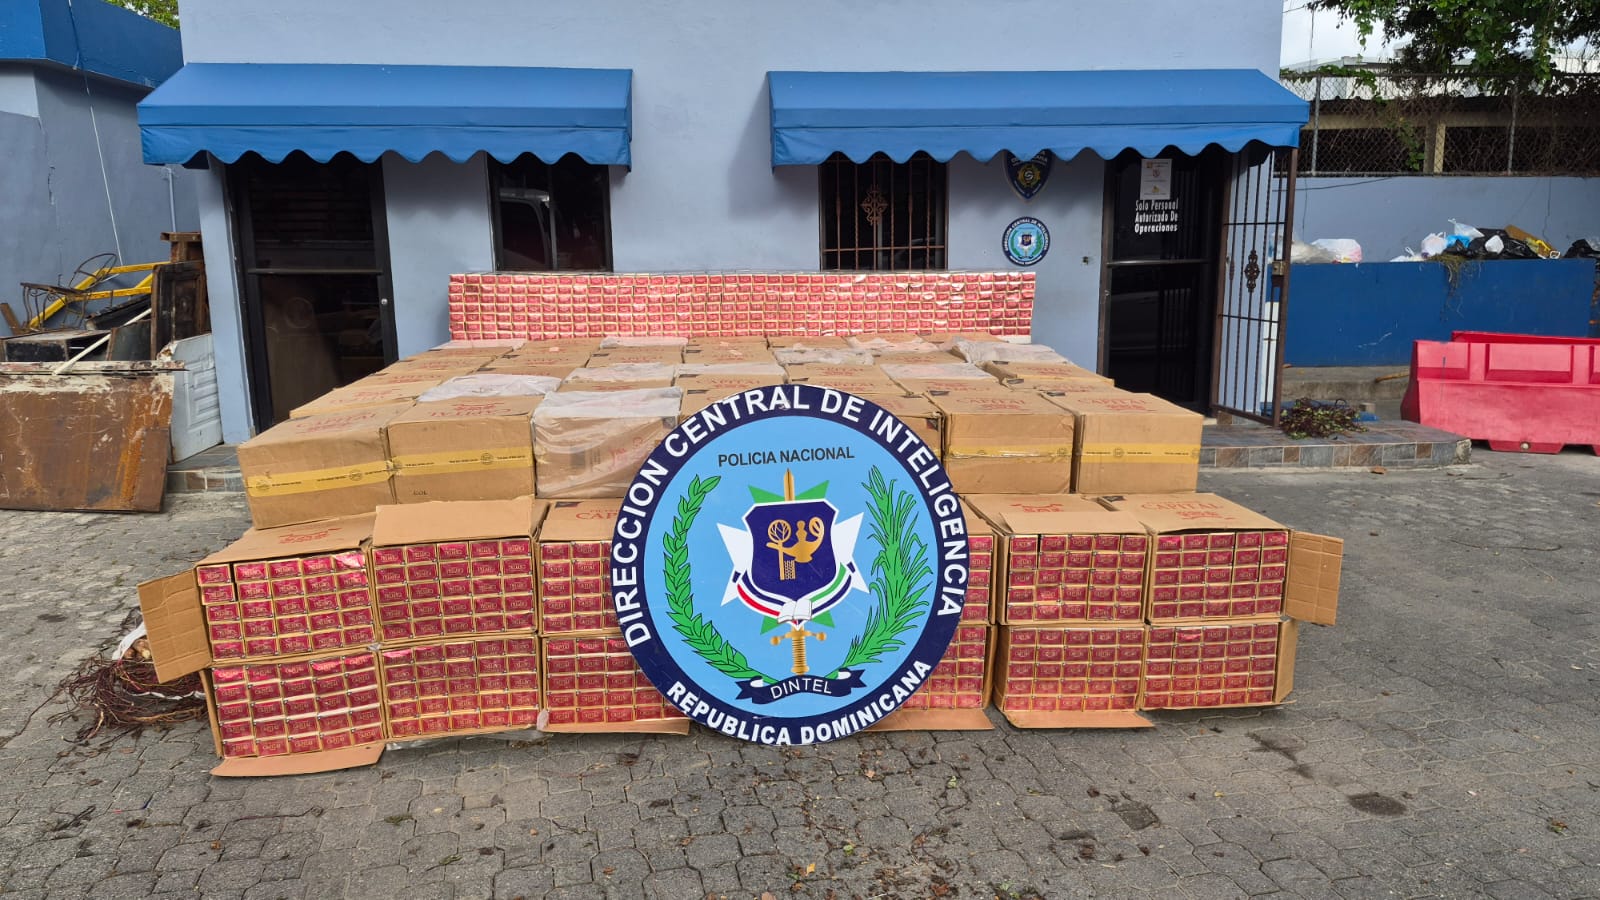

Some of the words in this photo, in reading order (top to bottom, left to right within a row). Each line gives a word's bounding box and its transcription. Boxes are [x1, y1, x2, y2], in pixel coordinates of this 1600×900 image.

[1136, 200, 1149, 210] Solo
[1151, 198, 1178, 210] Personal
[1135, 212, 1168, 222] Autorizado
[1170, 210, 1178, 222] De
[1134, 222, 1178, 235] Operaciones
[718, 450, 778, 467] POLICIA
[780, 446, 854, 464] NACIONAL
[612, 458, 669, 648] DIRECCION
[664, 386, 810, 457] CENTRAL
[820, 388, 865, 422] DE
[868, 405, 968, 616] INTELIGENCIA
[770, 678, 832, 700] DINTEL
[667, 680, 791, 746] REPUBLICA
[801, 660, 932, 744] DOMINICANA
